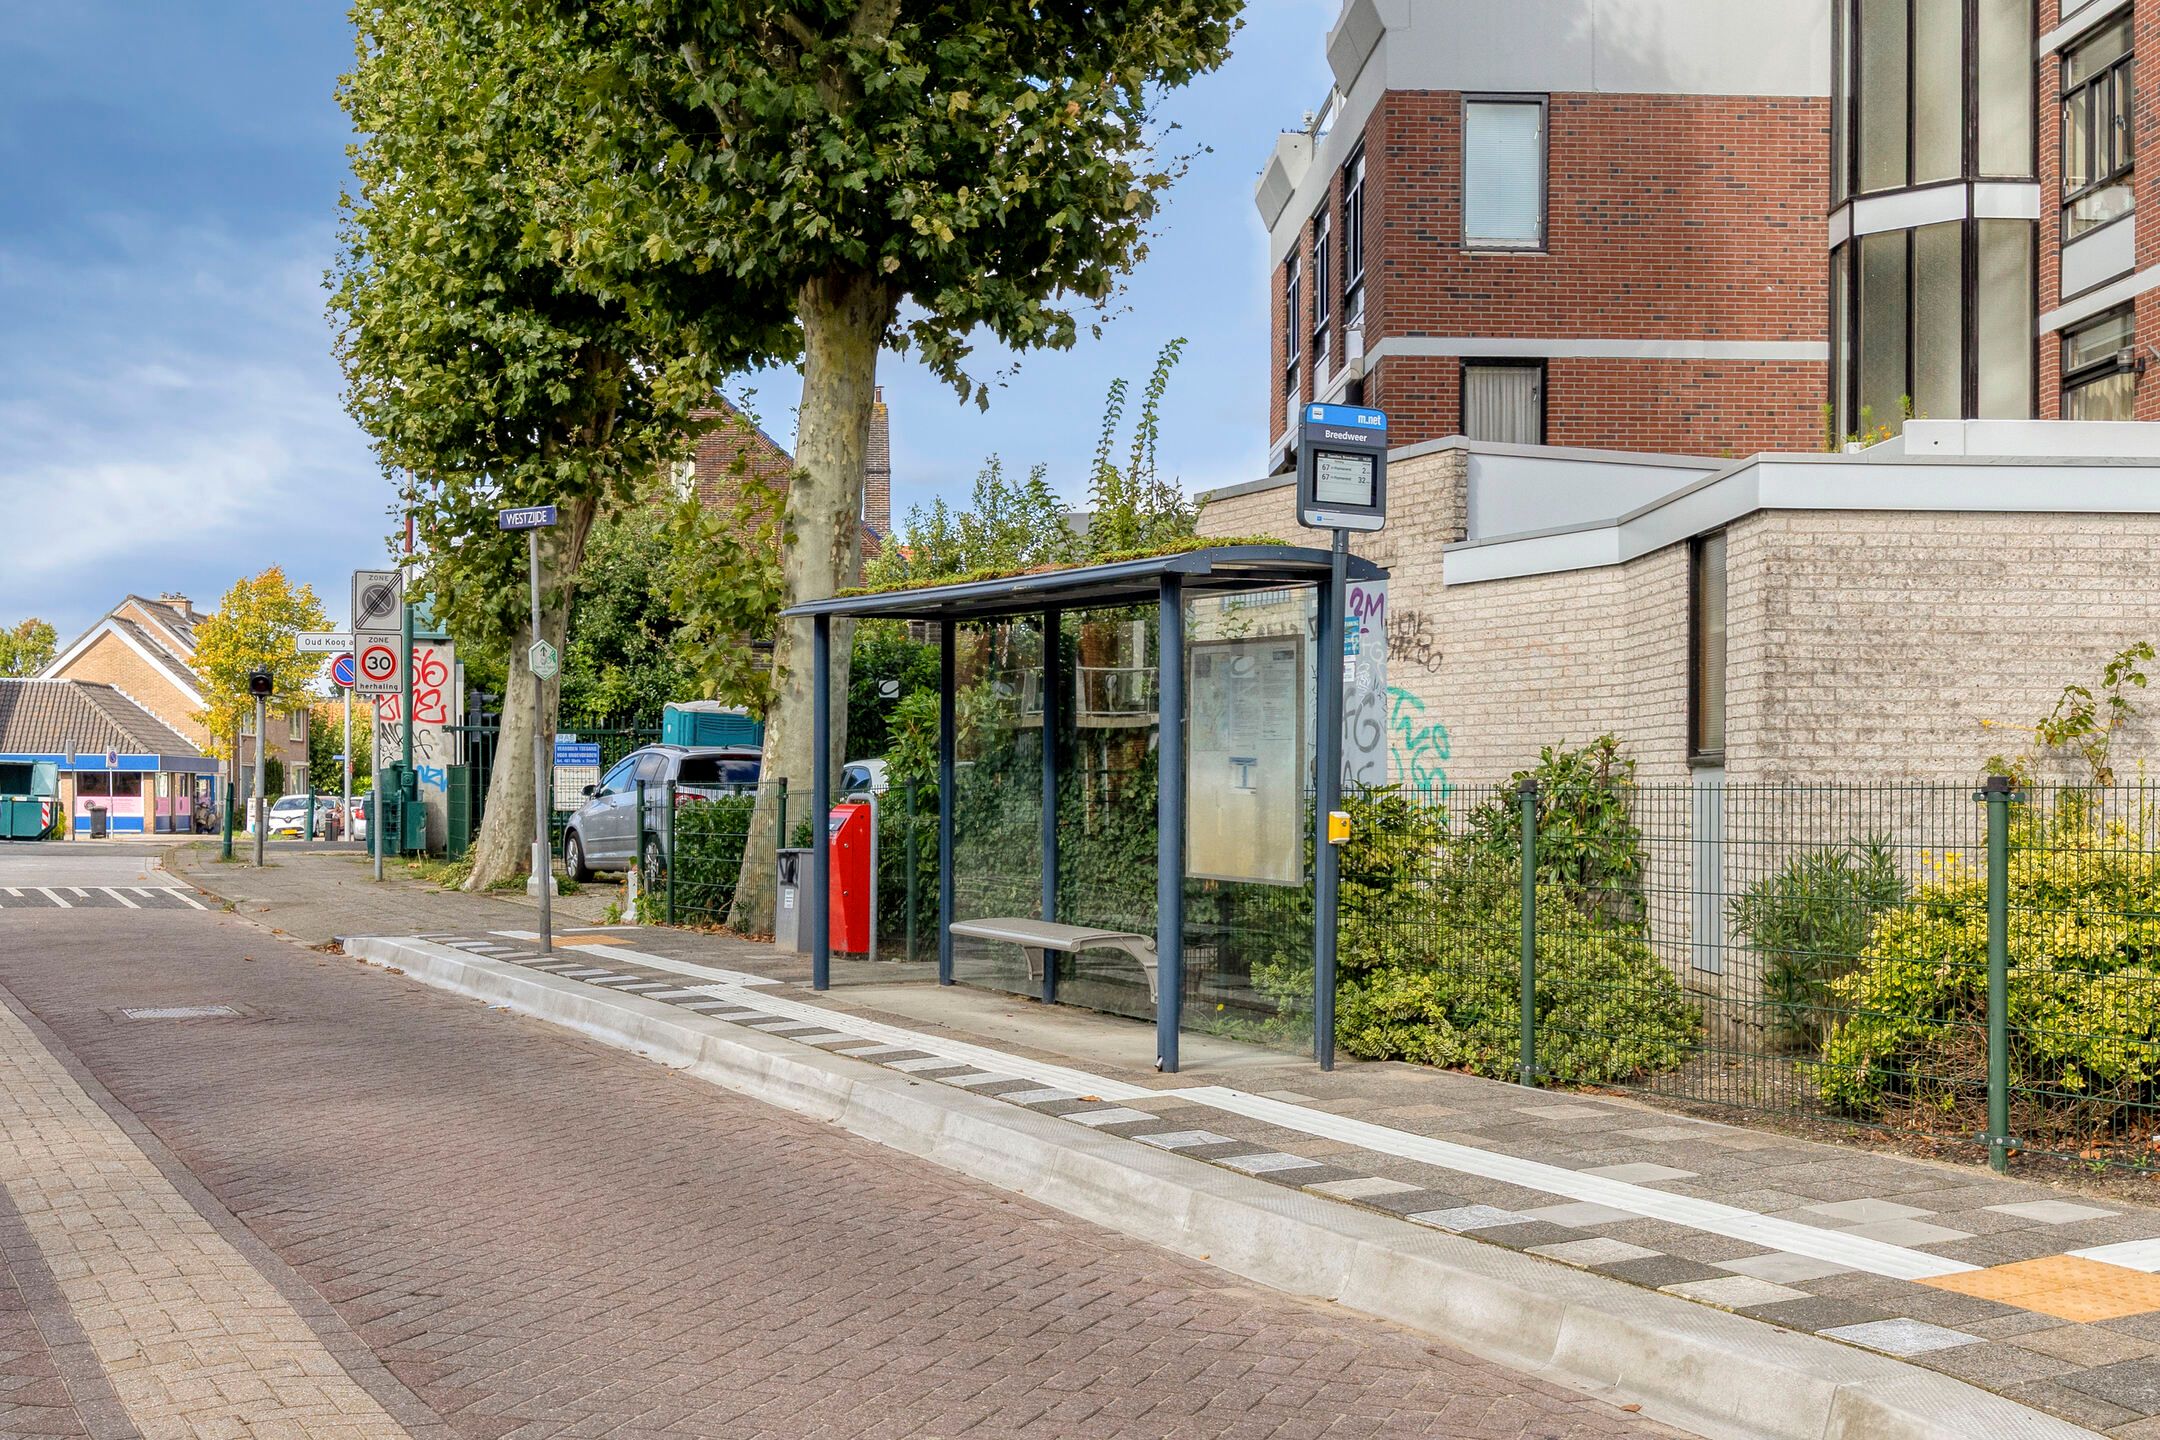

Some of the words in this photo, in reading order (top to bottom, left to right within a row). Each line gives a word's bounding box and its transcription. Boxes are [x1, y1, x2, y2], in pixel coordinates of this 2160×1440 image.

[1357, 414, 1381, 426] m.net
[1325, 429, 1368, 442] Breedweer
[1321, 463, 1330, 471] 67
[1321, 473, 1330, 481] 67
[1358, 476, 1366, 484] 32
[505, 510, 547, 526] WESTZIJDE
[368, 574, 389, 582] ZONE
[304, 638, 322, 646] Oud
[325, 639, 346, 647] Koog
[367, 656, 391, 670] 30
[360, 683, 398, 693] herhaling
